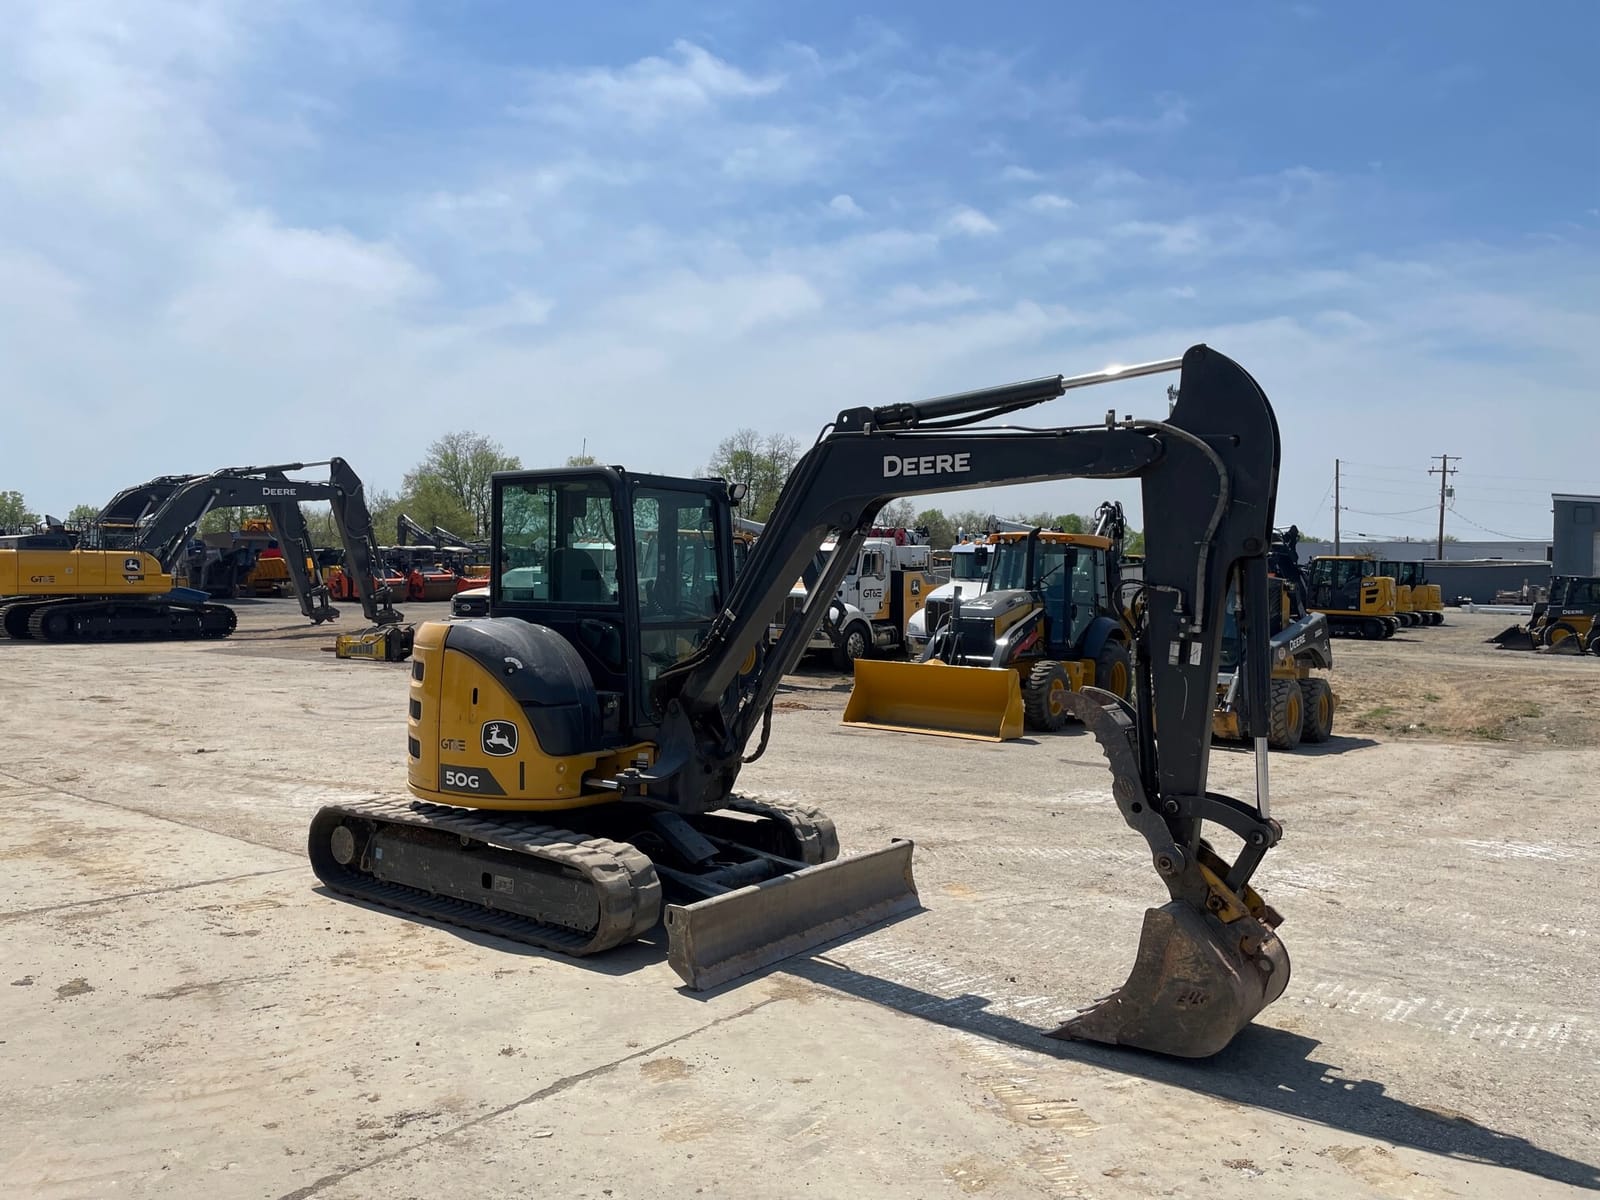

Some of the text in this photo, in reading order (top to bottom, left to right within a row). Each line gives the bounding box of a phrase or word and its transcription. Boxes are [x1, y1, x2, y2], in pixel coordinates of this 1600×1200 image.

[883, 452, 971, 478] DEERE
[262, 487, 297, 496] DEERE
[1290, 633, 1306, 651] DEERE
[446, 770, 479, 788] 50G
